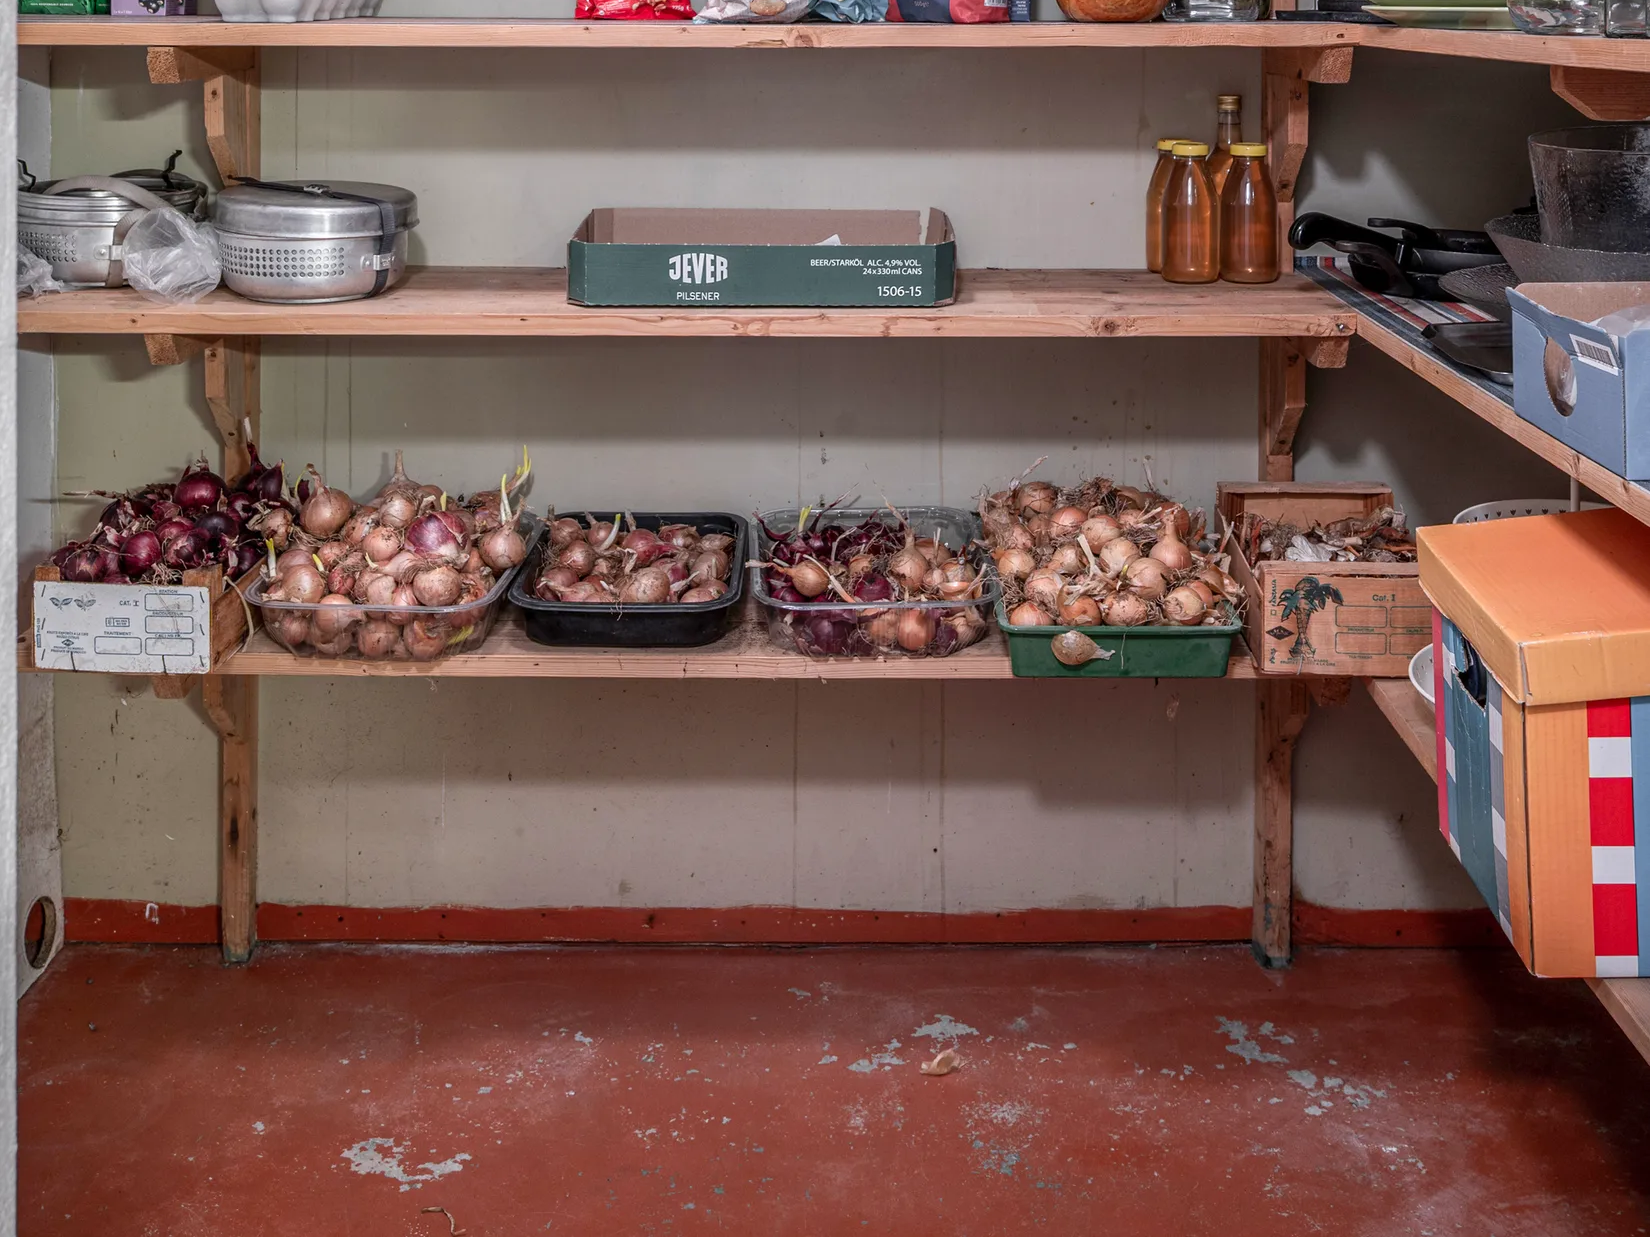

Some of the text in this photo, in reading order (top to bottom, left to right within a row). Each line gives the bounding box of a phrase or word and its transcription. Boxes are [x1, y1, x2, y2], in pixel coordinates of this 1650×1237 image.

[668, 252, 728, 284] JEVER
[810, 258, 922, 268] BEER/STARKÖL ALC. 4,9% VOL.
[901, 267, 923, 275] CANS
[676, 291, 720, 301] PILSENER
[877, 285, 922, 297] 1506-15
[1372, 594, 1389, 602] Cat.
